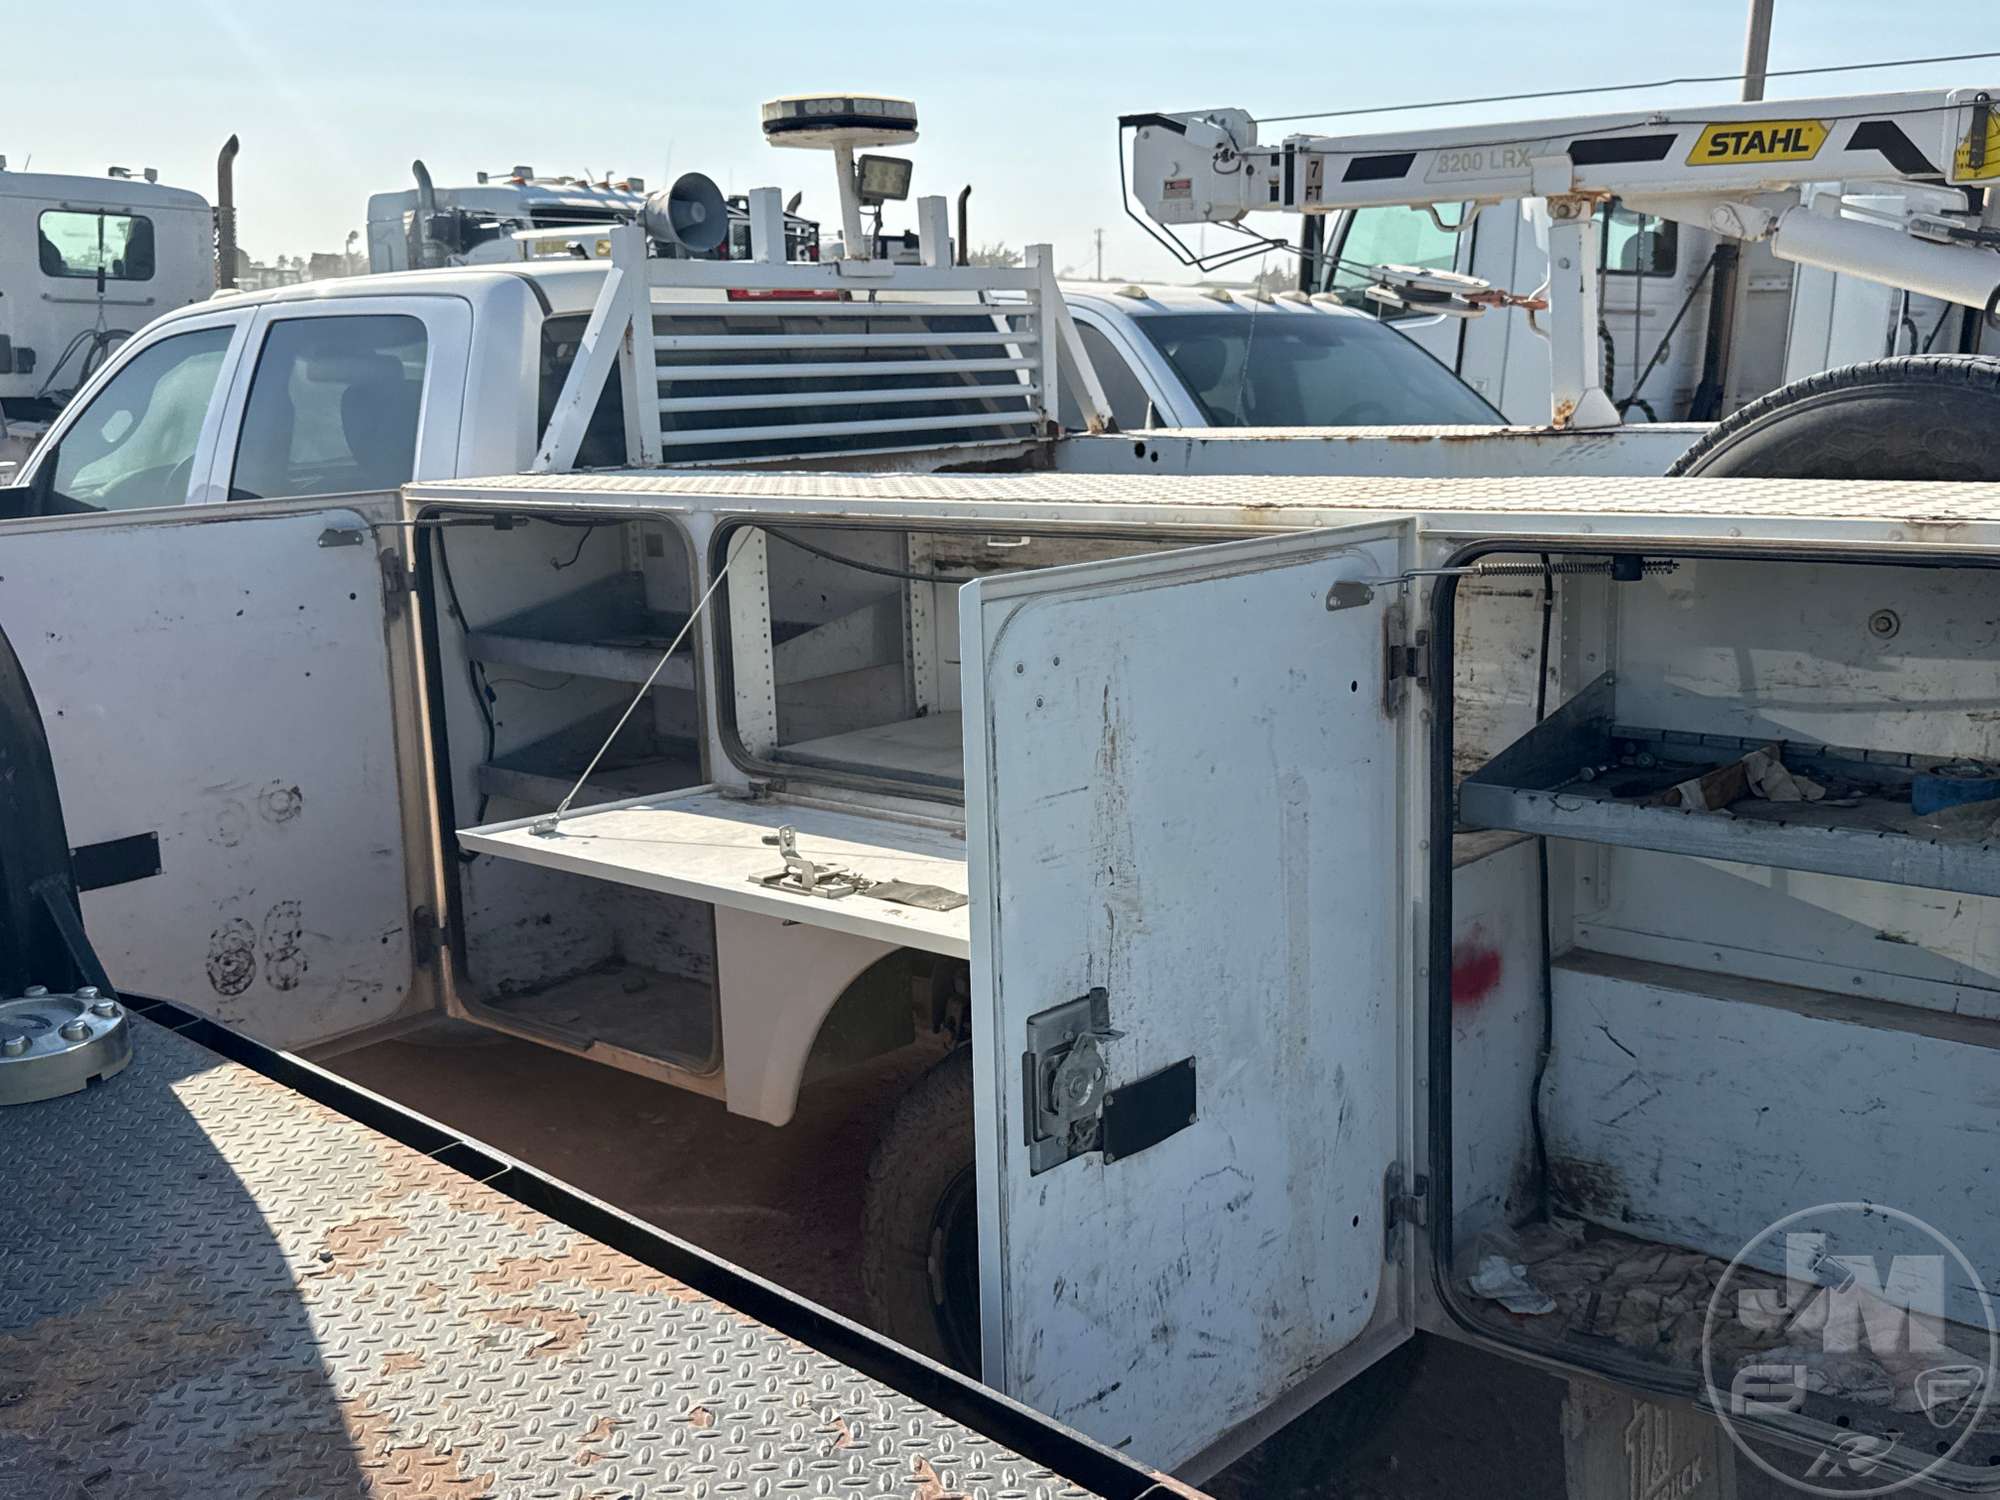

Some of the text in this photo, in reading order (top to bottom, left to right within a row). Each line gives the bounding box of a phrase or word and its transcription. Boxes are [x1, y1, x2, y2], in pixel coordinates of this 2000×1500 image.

[1707, 127, 1810, 157] STAHL
[1489, 146, 1531, 170] LRX
[1309, 160, 1321, 180] 7
[1305, 184, 1323, 202] FT
